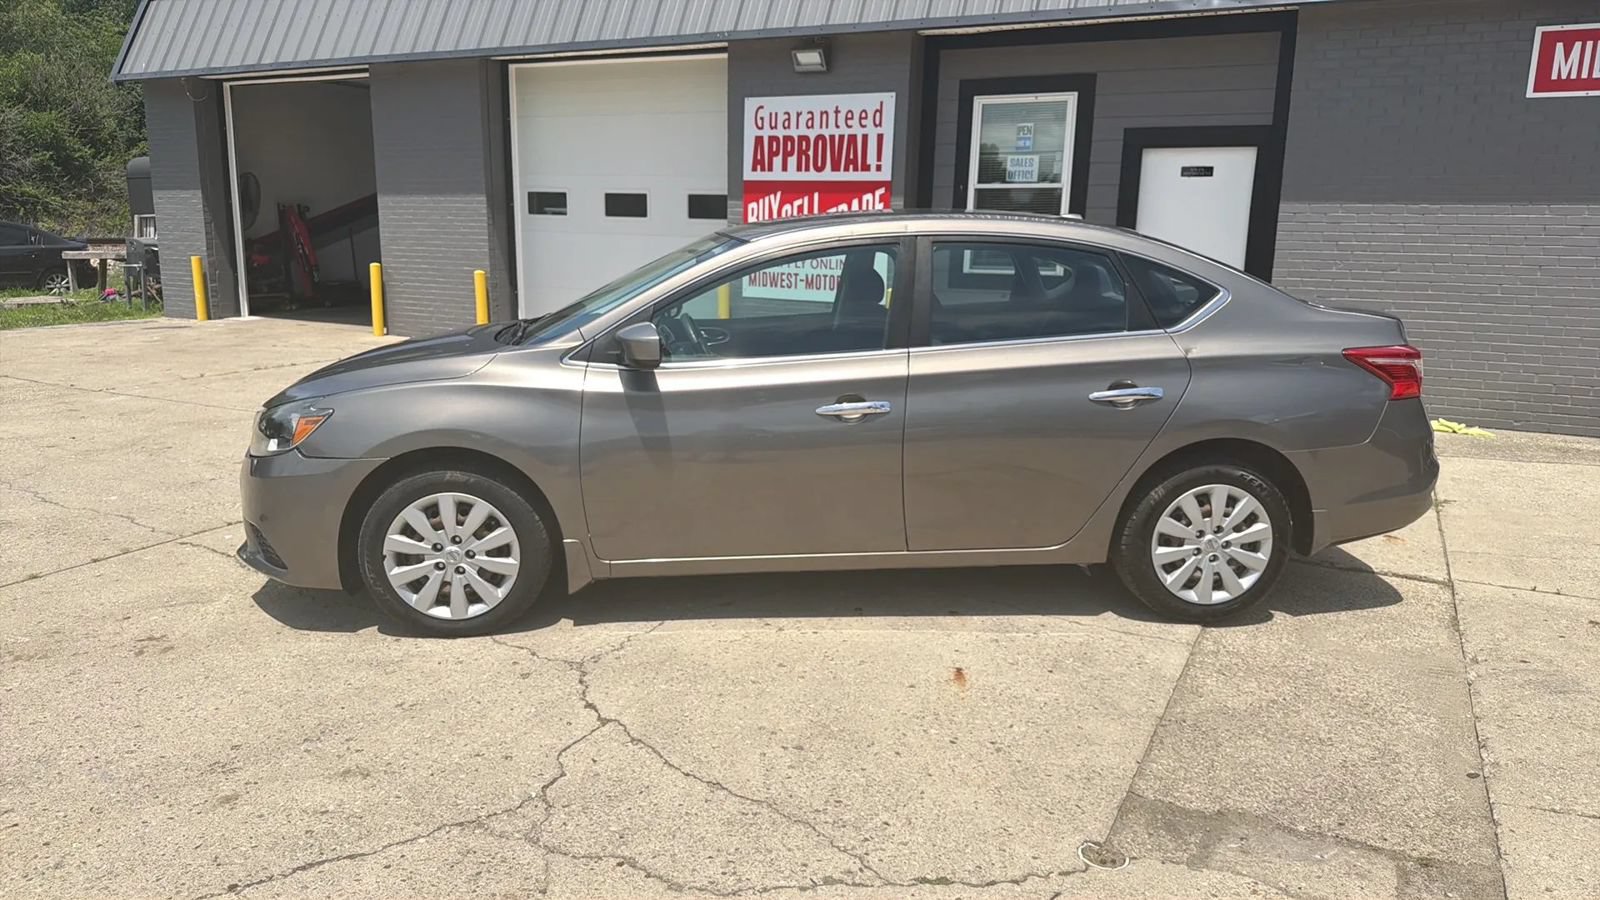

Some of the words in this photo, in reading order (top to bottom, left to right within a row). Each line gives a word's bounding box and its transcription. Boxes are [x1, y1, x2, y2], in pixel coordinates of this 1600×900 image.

[754, 101, 884, 131] Guaranteed
[751, 133, 885, 173] APPROVAL!
[1010, 157, 1034, 168] SALES
[1008, 170, 1034, 180] OFFICE
